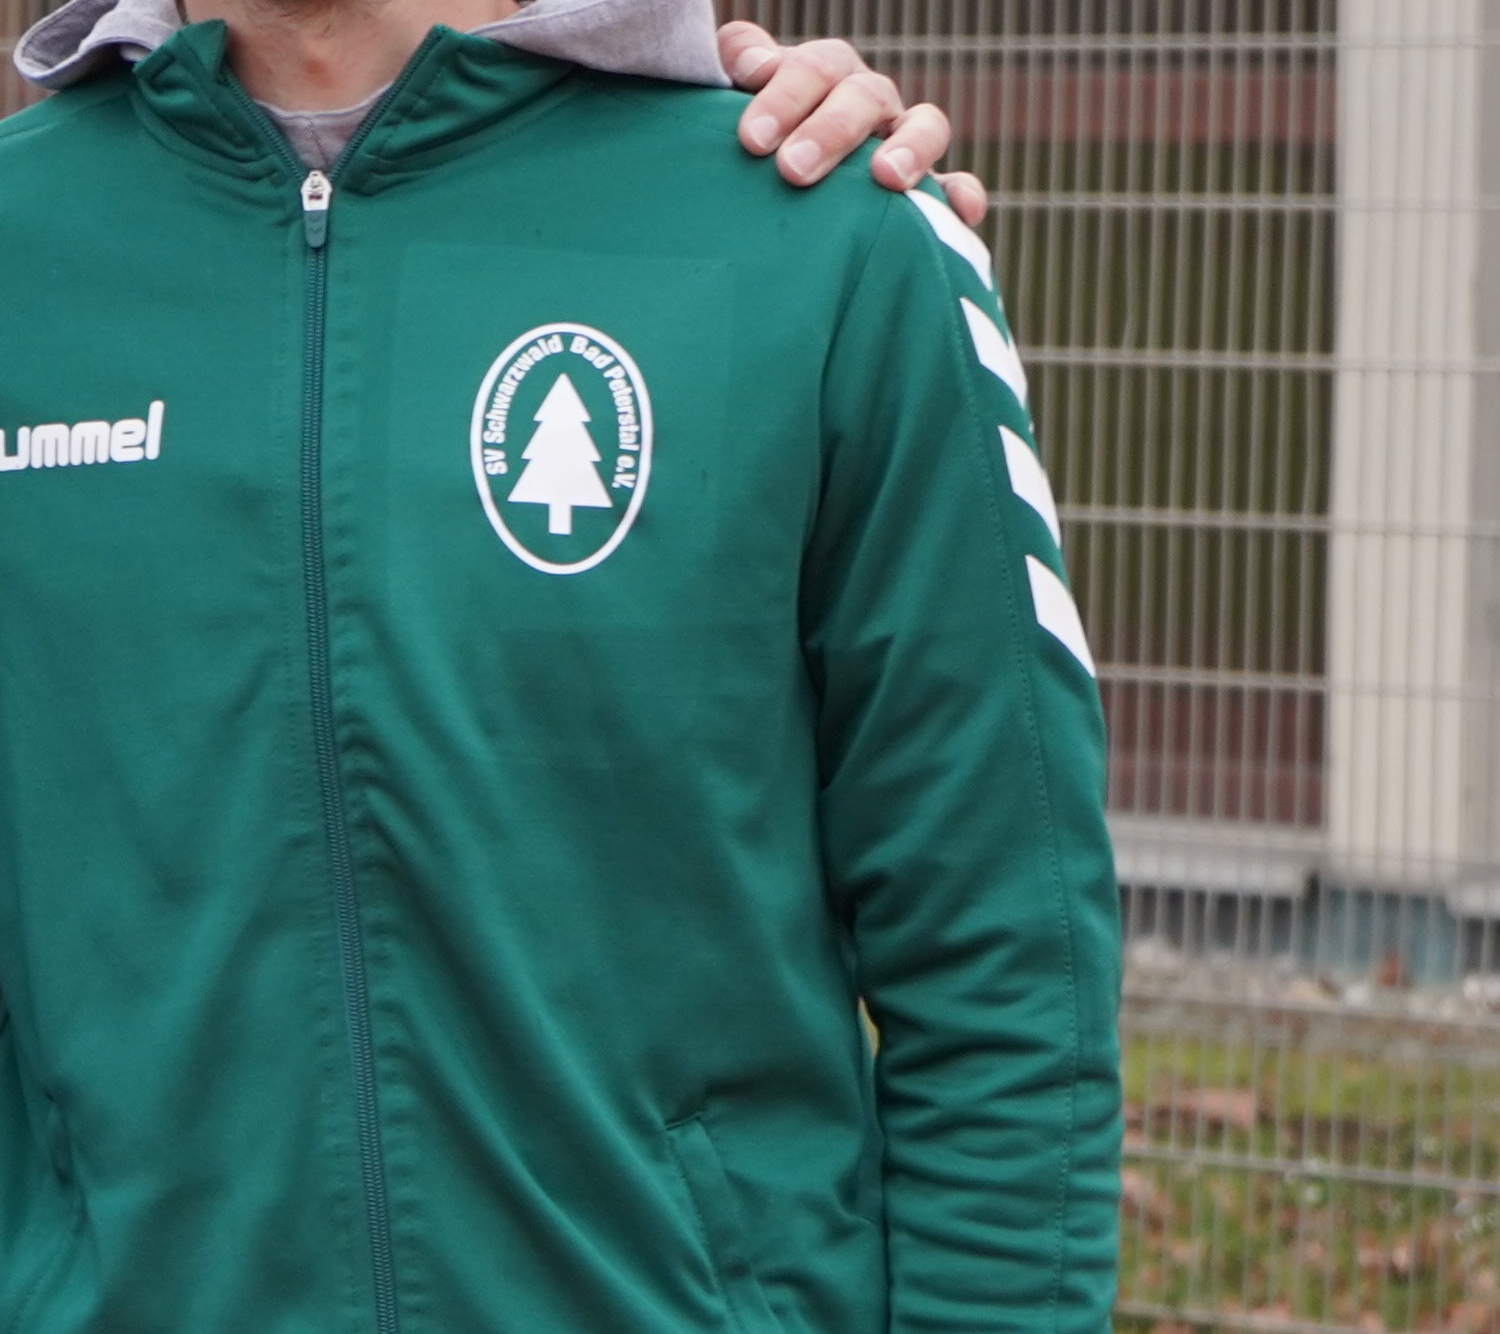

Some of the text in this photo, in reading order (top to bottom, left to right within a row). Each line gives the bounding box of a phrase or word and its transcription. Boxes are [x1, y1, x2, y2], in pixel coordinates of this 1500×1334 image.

[483, 334, 640, 488] SV Schwarzwald Bad Peterstal e.V.
